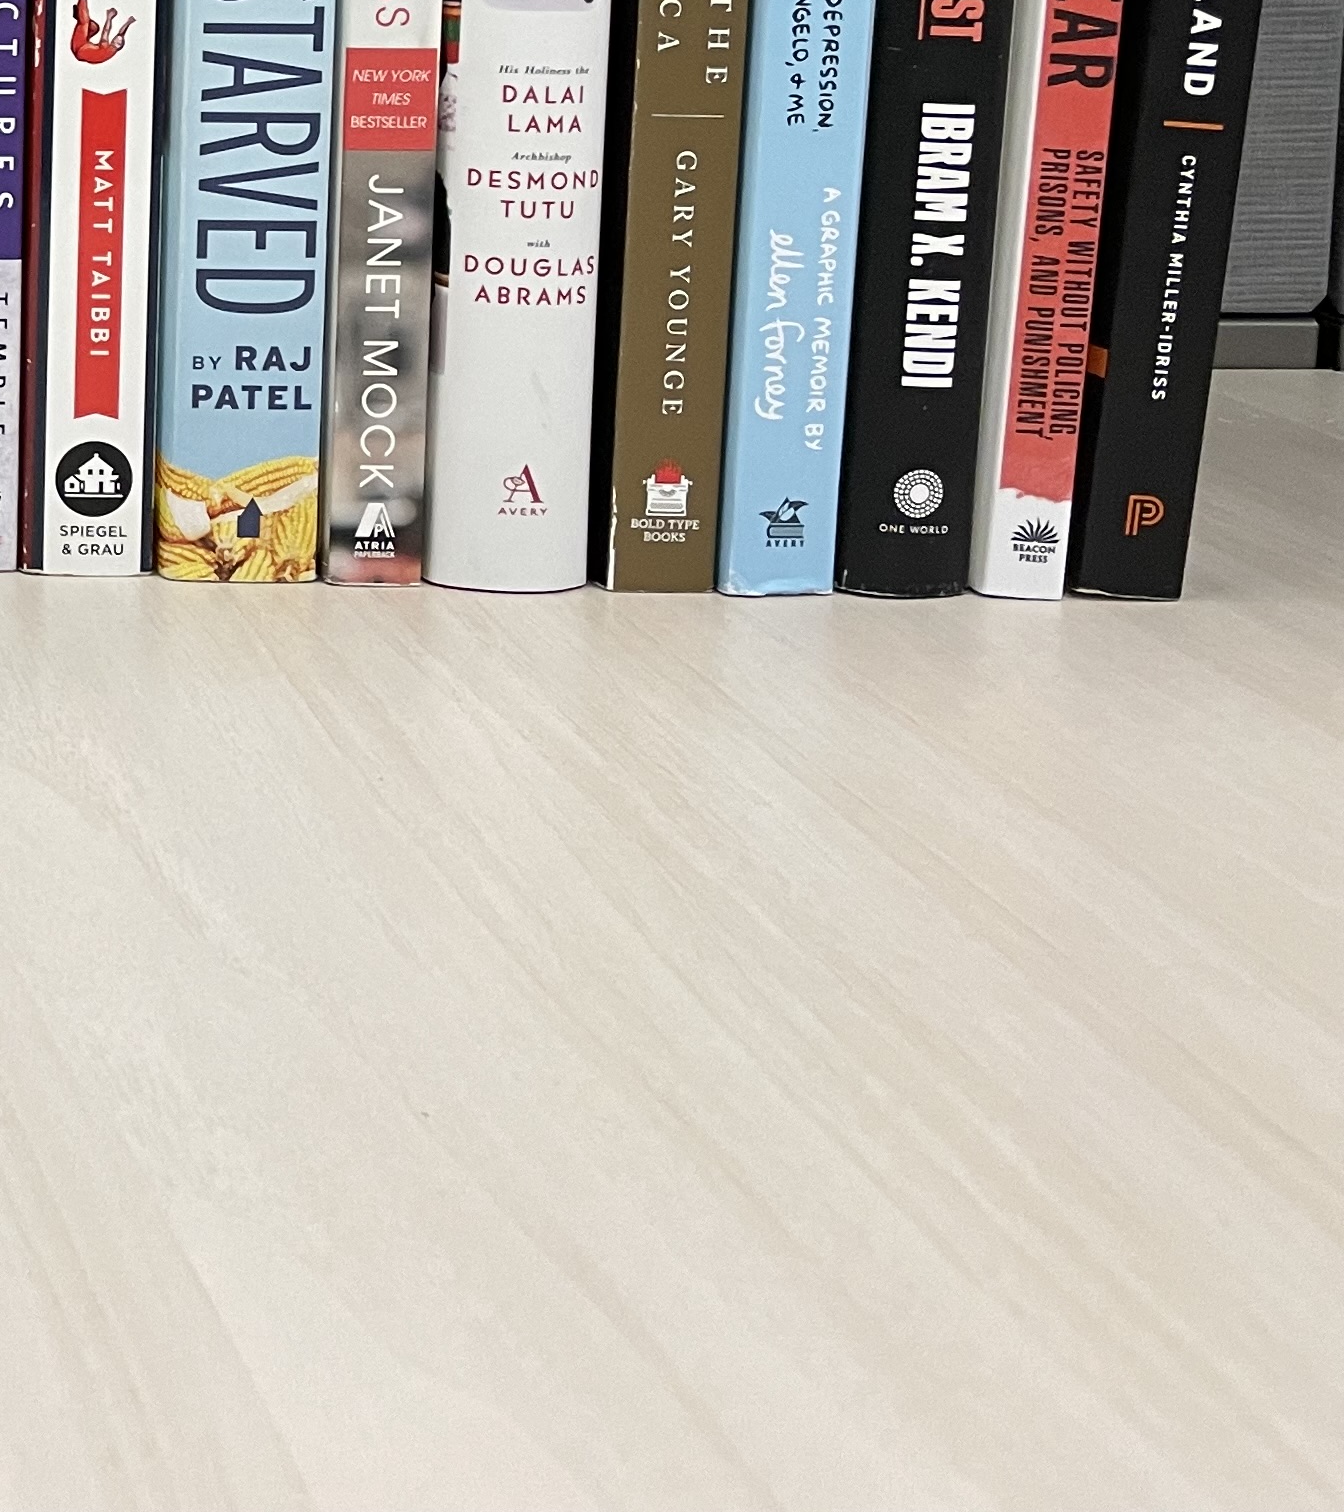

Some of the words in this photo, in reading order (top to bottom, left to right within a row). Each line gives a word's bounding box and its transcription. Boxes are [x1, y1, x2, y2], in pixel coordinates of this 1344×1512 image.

[502, 85, 584, 104] DALAI
[350, 115, 427, 129] BESTSELLER
[508, 114, 582, 133] LAMA
[672, 150, 698, 248] GARY
[824, 187, 842, 202] A
[1170, 155, 1197, 245] CYNTHIA
[364, 174, 406, 319] JANET
[464, 255, 594, 277] DOUGLAS
[817, 210, 841, 306] GRAPHIC
[765, 229, 805, 312] ellen
[474, 285, 586, 305] ABRAMS
[1151, 253, 1185, 400] MILLER-IDRISS
[662, 265, 691, 415] YOUNGE
[192, 356, 222, 370] BY
[235, 346, 312, 371] RAJ
[755, 317, 806, 420] forney
[806, 317, 832, 413] MEMOIR
[192, 385, 312, 410] PATEL
[359, 340, 399, 489] MOCK
[804, 423, 824, 450] BY
[498, 507, 548, 517] AVERY
[59, 525, 127, 537] SPIEGEL
[630, 518, 665, 530] BOLD
[668, 519, 700, 530] TYPE
[879, 524, 905, 533] ONE
[909, 524, 949, 535] WORLD
[354, 541, 394, 550] ATRIA
[643, 532, 686, 543] BOOKS
[62, 543, 71, 555] &
[78, 544, 124, 555] GRAU
[1012, 543, 1056, 554] BEACON
[1019, 554, 1048, 563] PRESS
